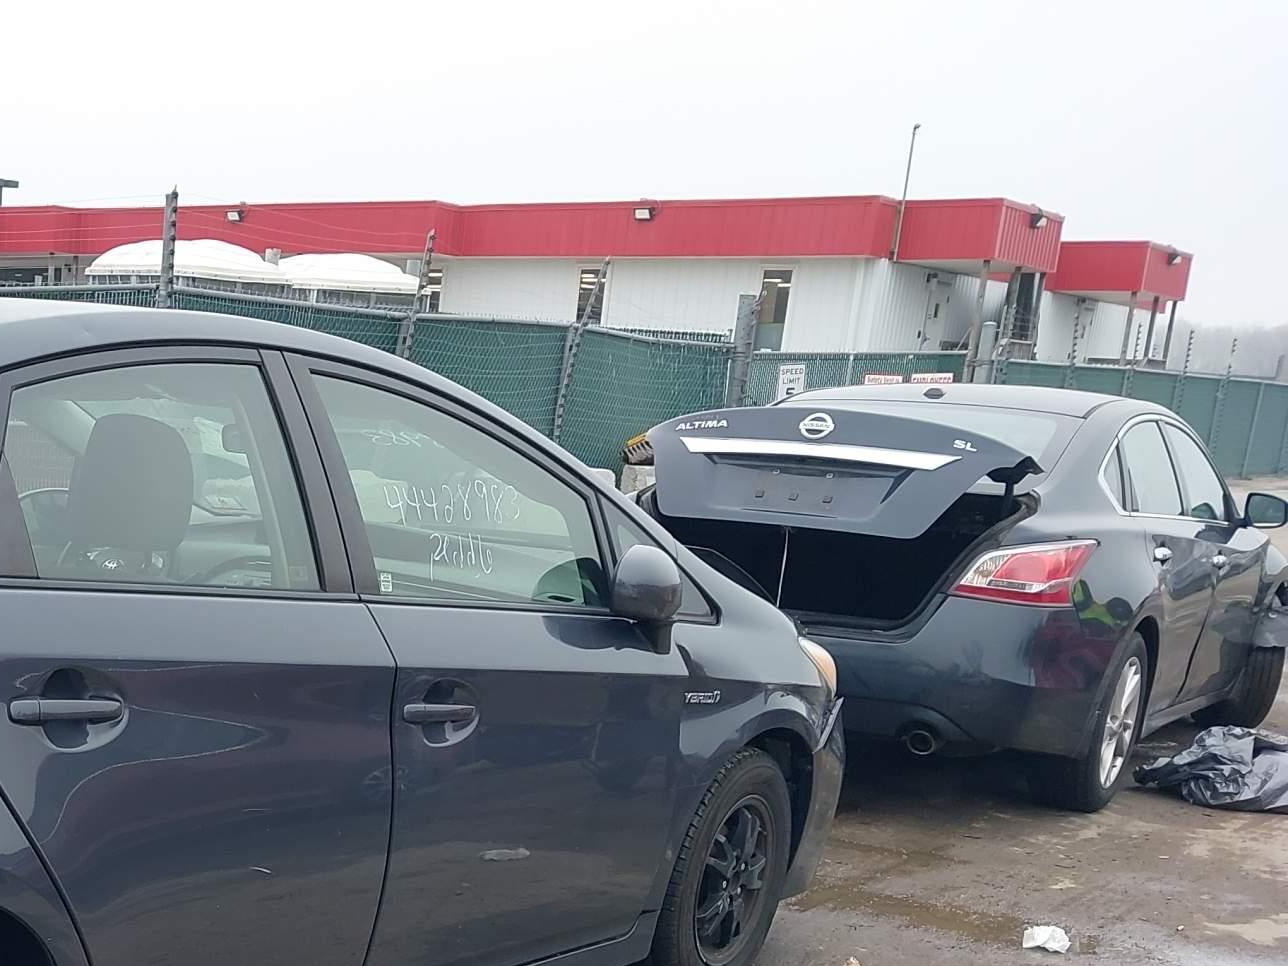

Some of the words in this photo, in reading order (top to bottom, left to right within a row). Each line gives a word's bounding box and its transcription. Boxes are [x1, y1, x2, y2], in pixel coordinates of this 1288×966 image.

[675, 419, 728, 431] ALTIMA
[953, 439, 978, 452] SL
[383, 480, 520, 528] 44428983
